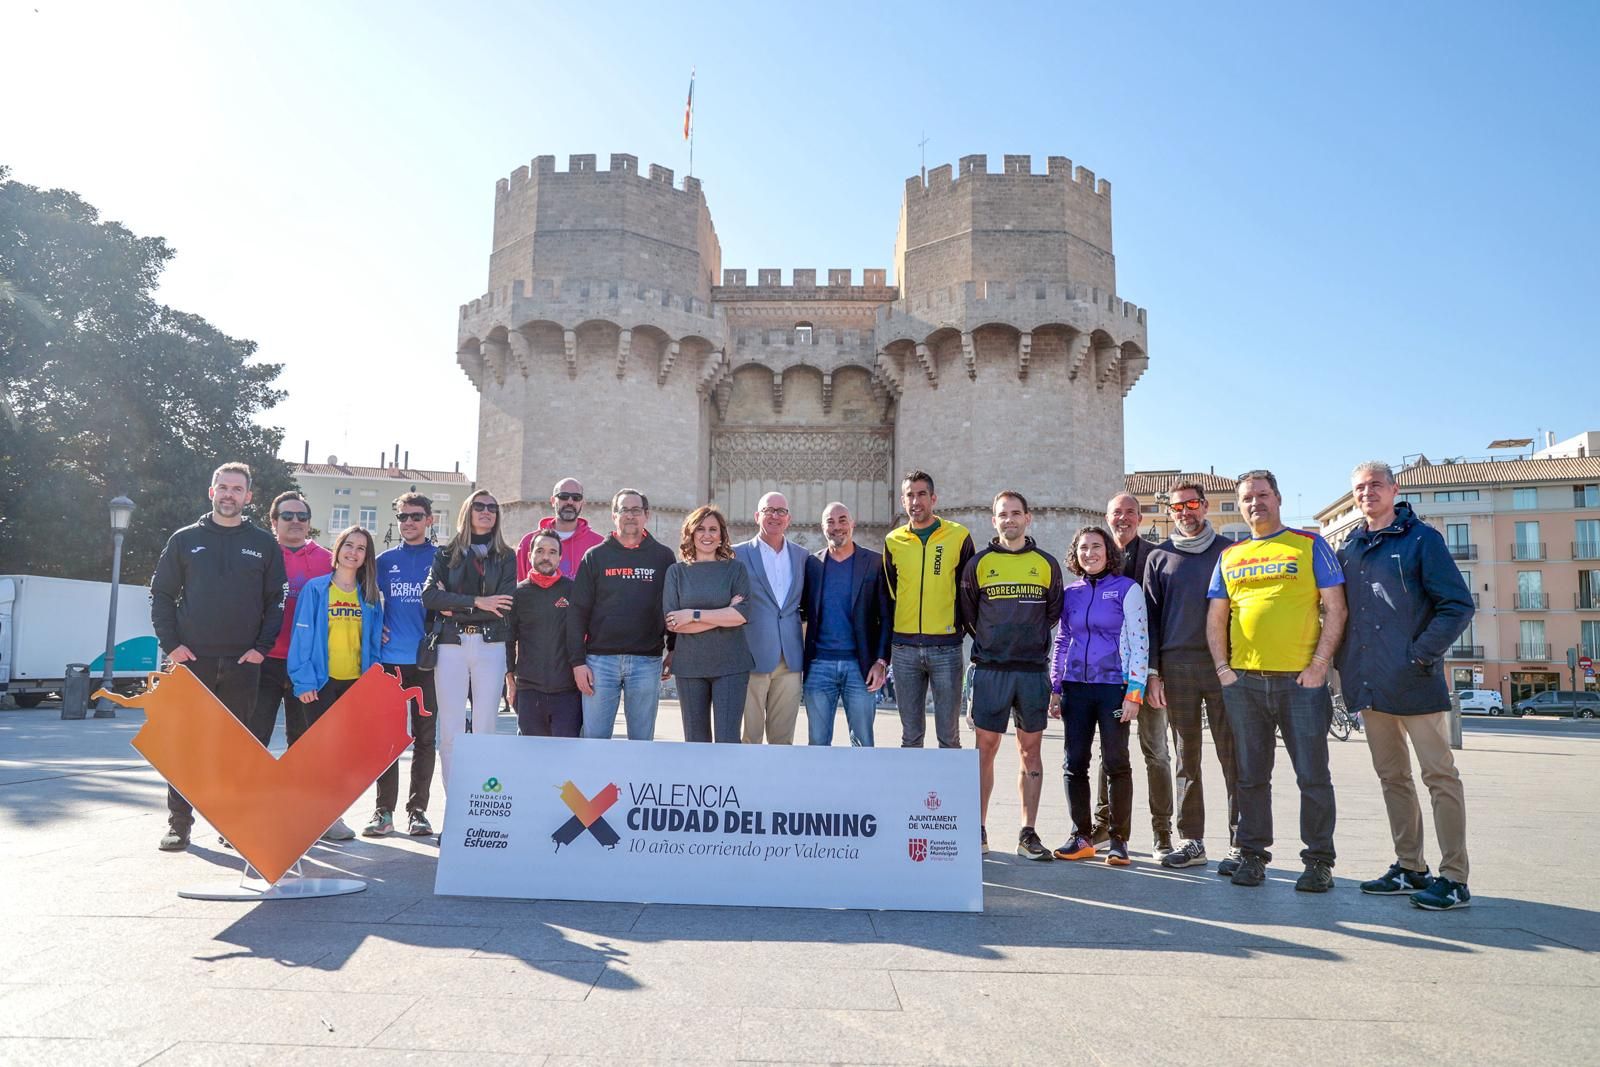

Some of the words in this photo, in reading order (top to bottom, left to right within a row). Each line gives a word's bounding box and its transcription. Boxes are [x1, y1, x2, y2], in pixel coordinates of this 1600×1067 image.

[605, 568, 633, 577] NEVER
[634, 568, 655, 576] STOP
[1226, 562, 1298, 582] runners
[986, 586, 1043, 596] CORRECAMINOS
[470, 793, 513, 801] FUNDACIÓN
[628, 782, 741, 809] VALENCIA
[469, 800, 512, 809] TRINIDAD
[468, 809, 511, 817] ALFONSO
[626, 807, 719, 833] CIUDAD
[723, 810, 766, 834] DEL
[771, 812, 877, 838] RUNNING
[908, 822, 919, 830] DE
[466, 828, 501, 839] Cultura
[464, 837, 508, 849] Esfuerzo
[629, 838, 646, 853] 10
[648, 839, 685, 855] años
[688, 841, 761, 857] corriendo
[764, 845, 792, 861] por
[794, 843, 860, 859] Valencia
